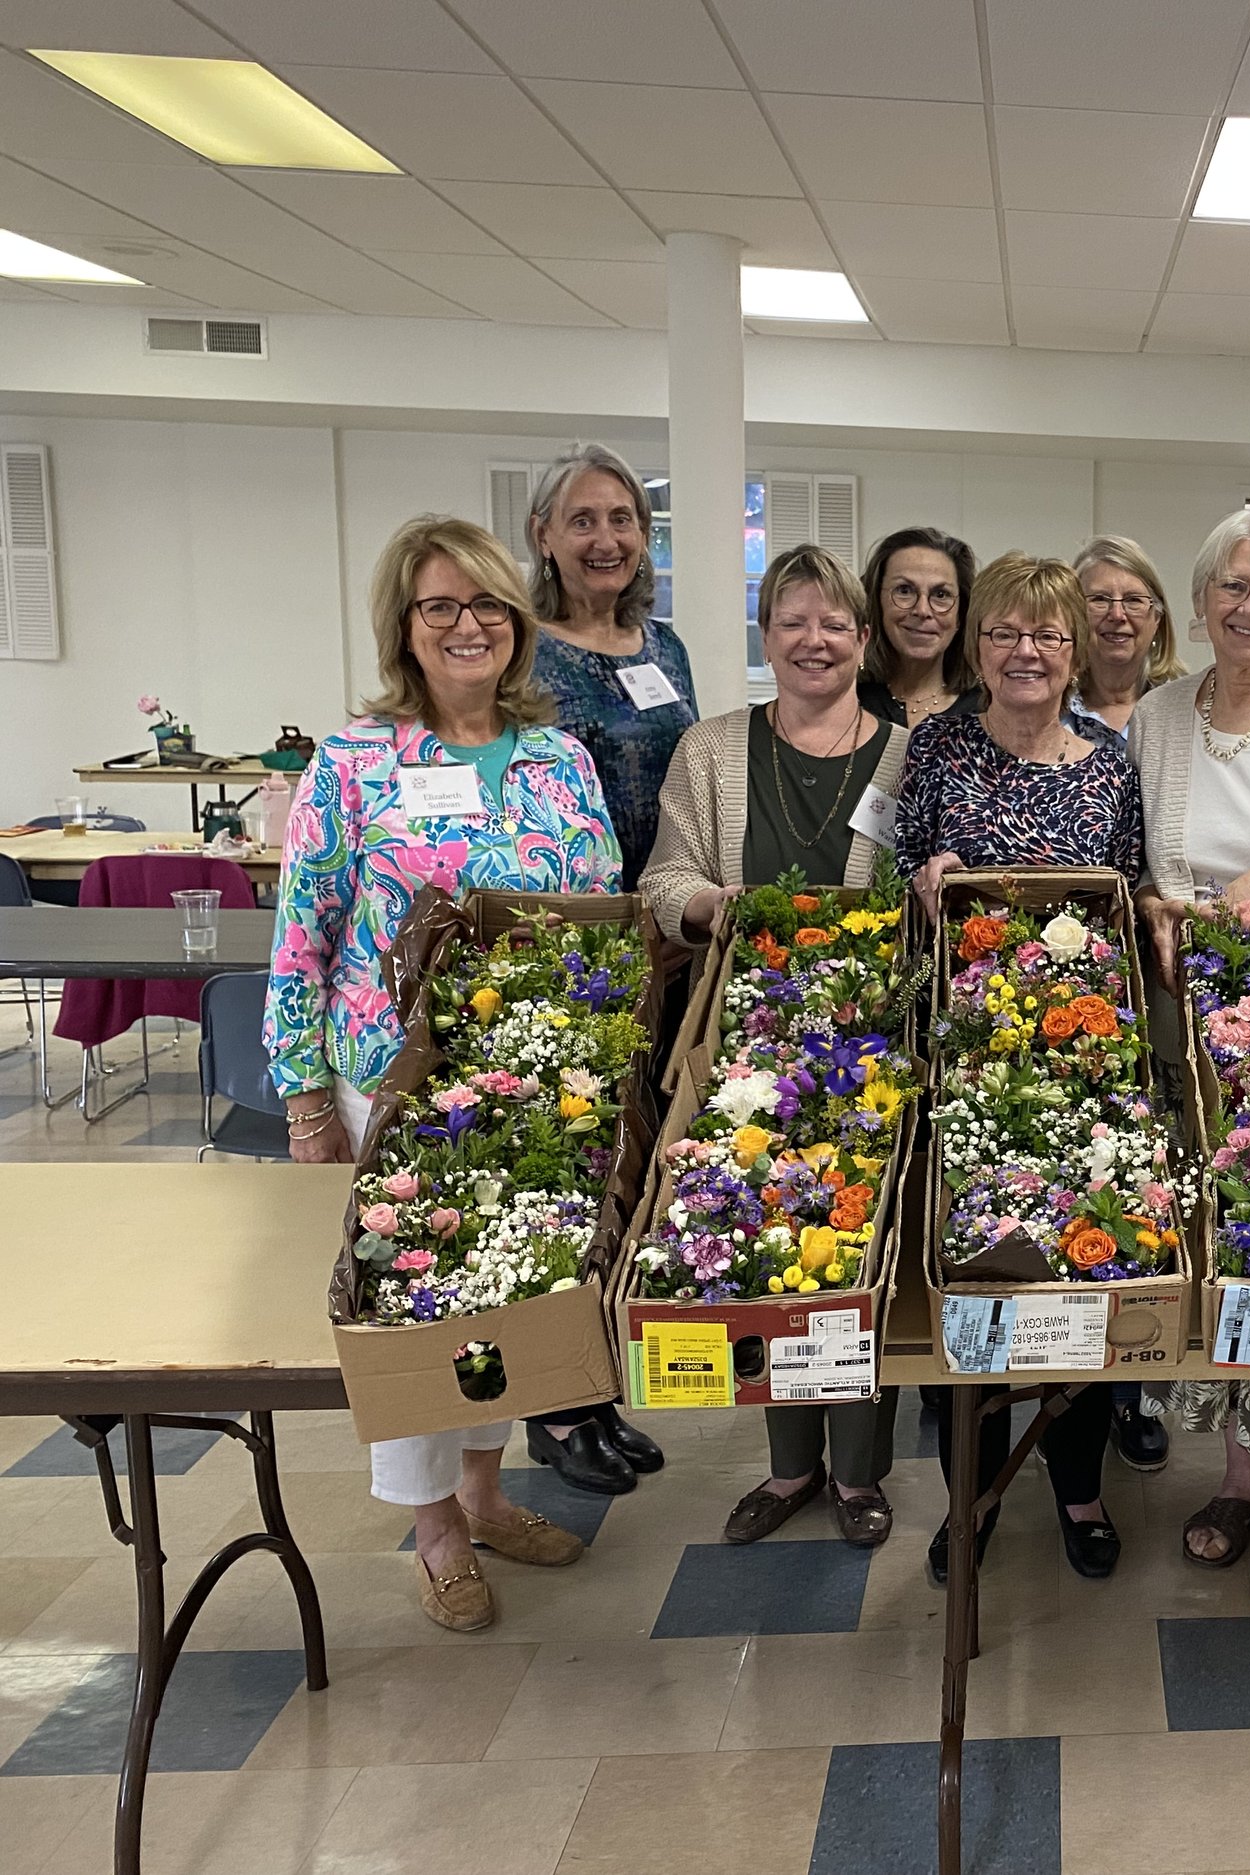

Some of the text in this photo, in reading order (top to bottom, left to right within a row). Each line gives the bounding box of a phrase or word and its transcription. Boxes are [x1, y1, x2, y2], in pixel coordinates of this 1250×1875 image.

[423, 791, 462, 801] Elizabeth
[428, 801, 461, 810] Sullivan
[1120, 1350, 1166, 1363] QB-P
